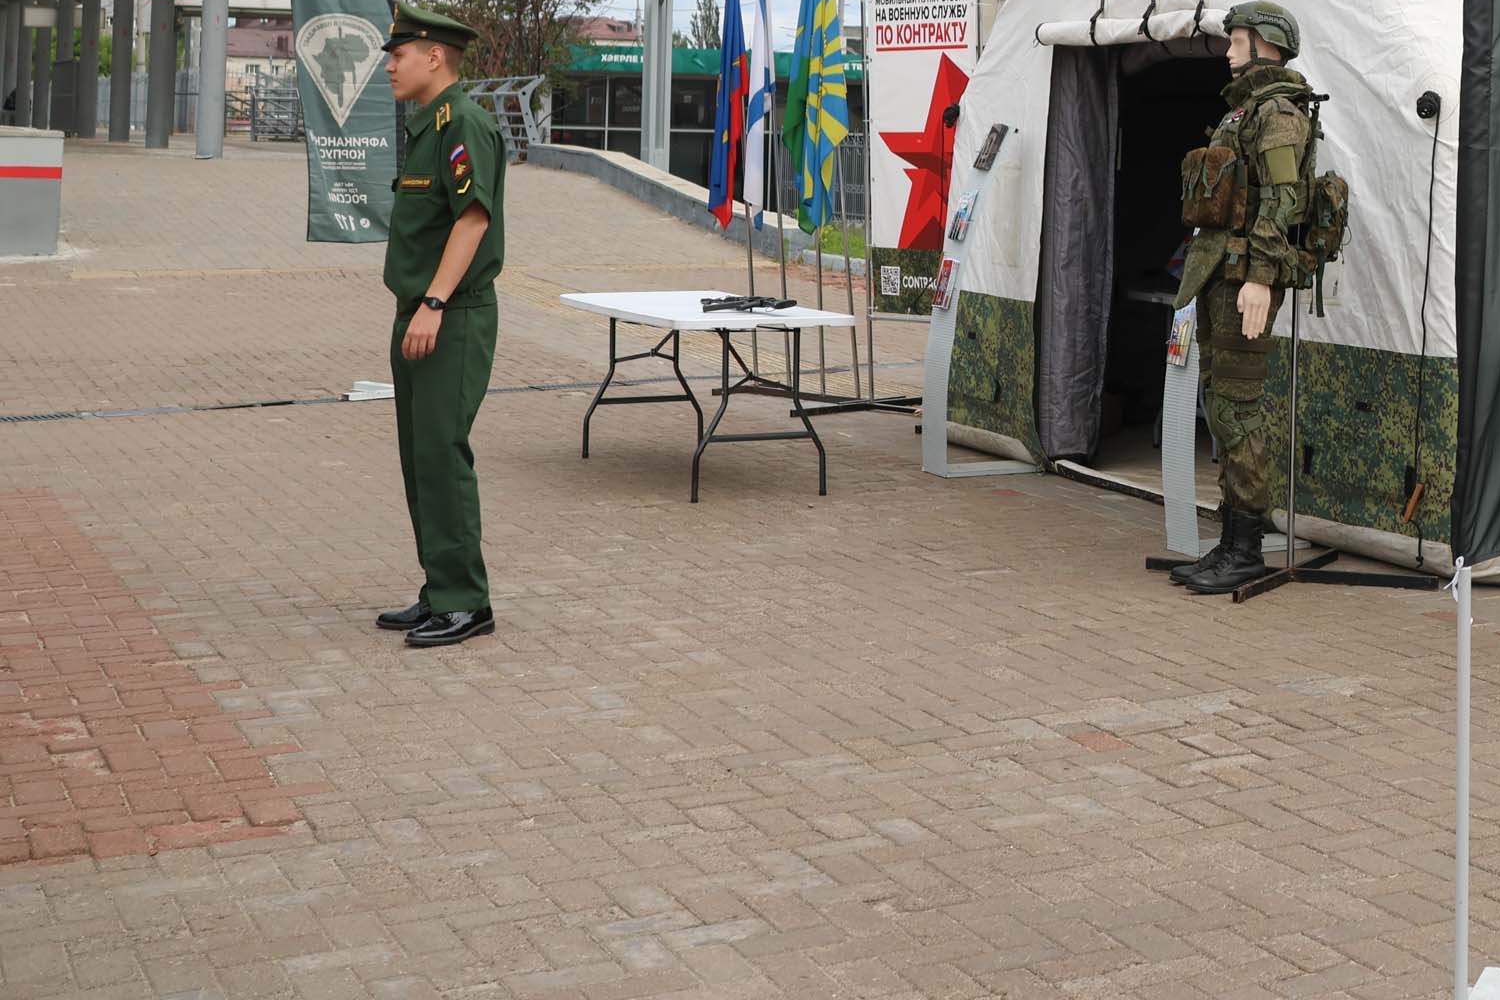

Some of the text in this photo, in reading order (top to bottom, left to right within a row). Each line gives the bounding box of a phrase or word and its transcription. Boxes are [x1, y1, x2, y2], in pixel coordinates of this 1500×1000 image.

[875, 4, 968, 22] НА ВОЕННУЮ СЛУЖБУ
[875, 21, 967, 45] ПО КОНТРАКТУ
